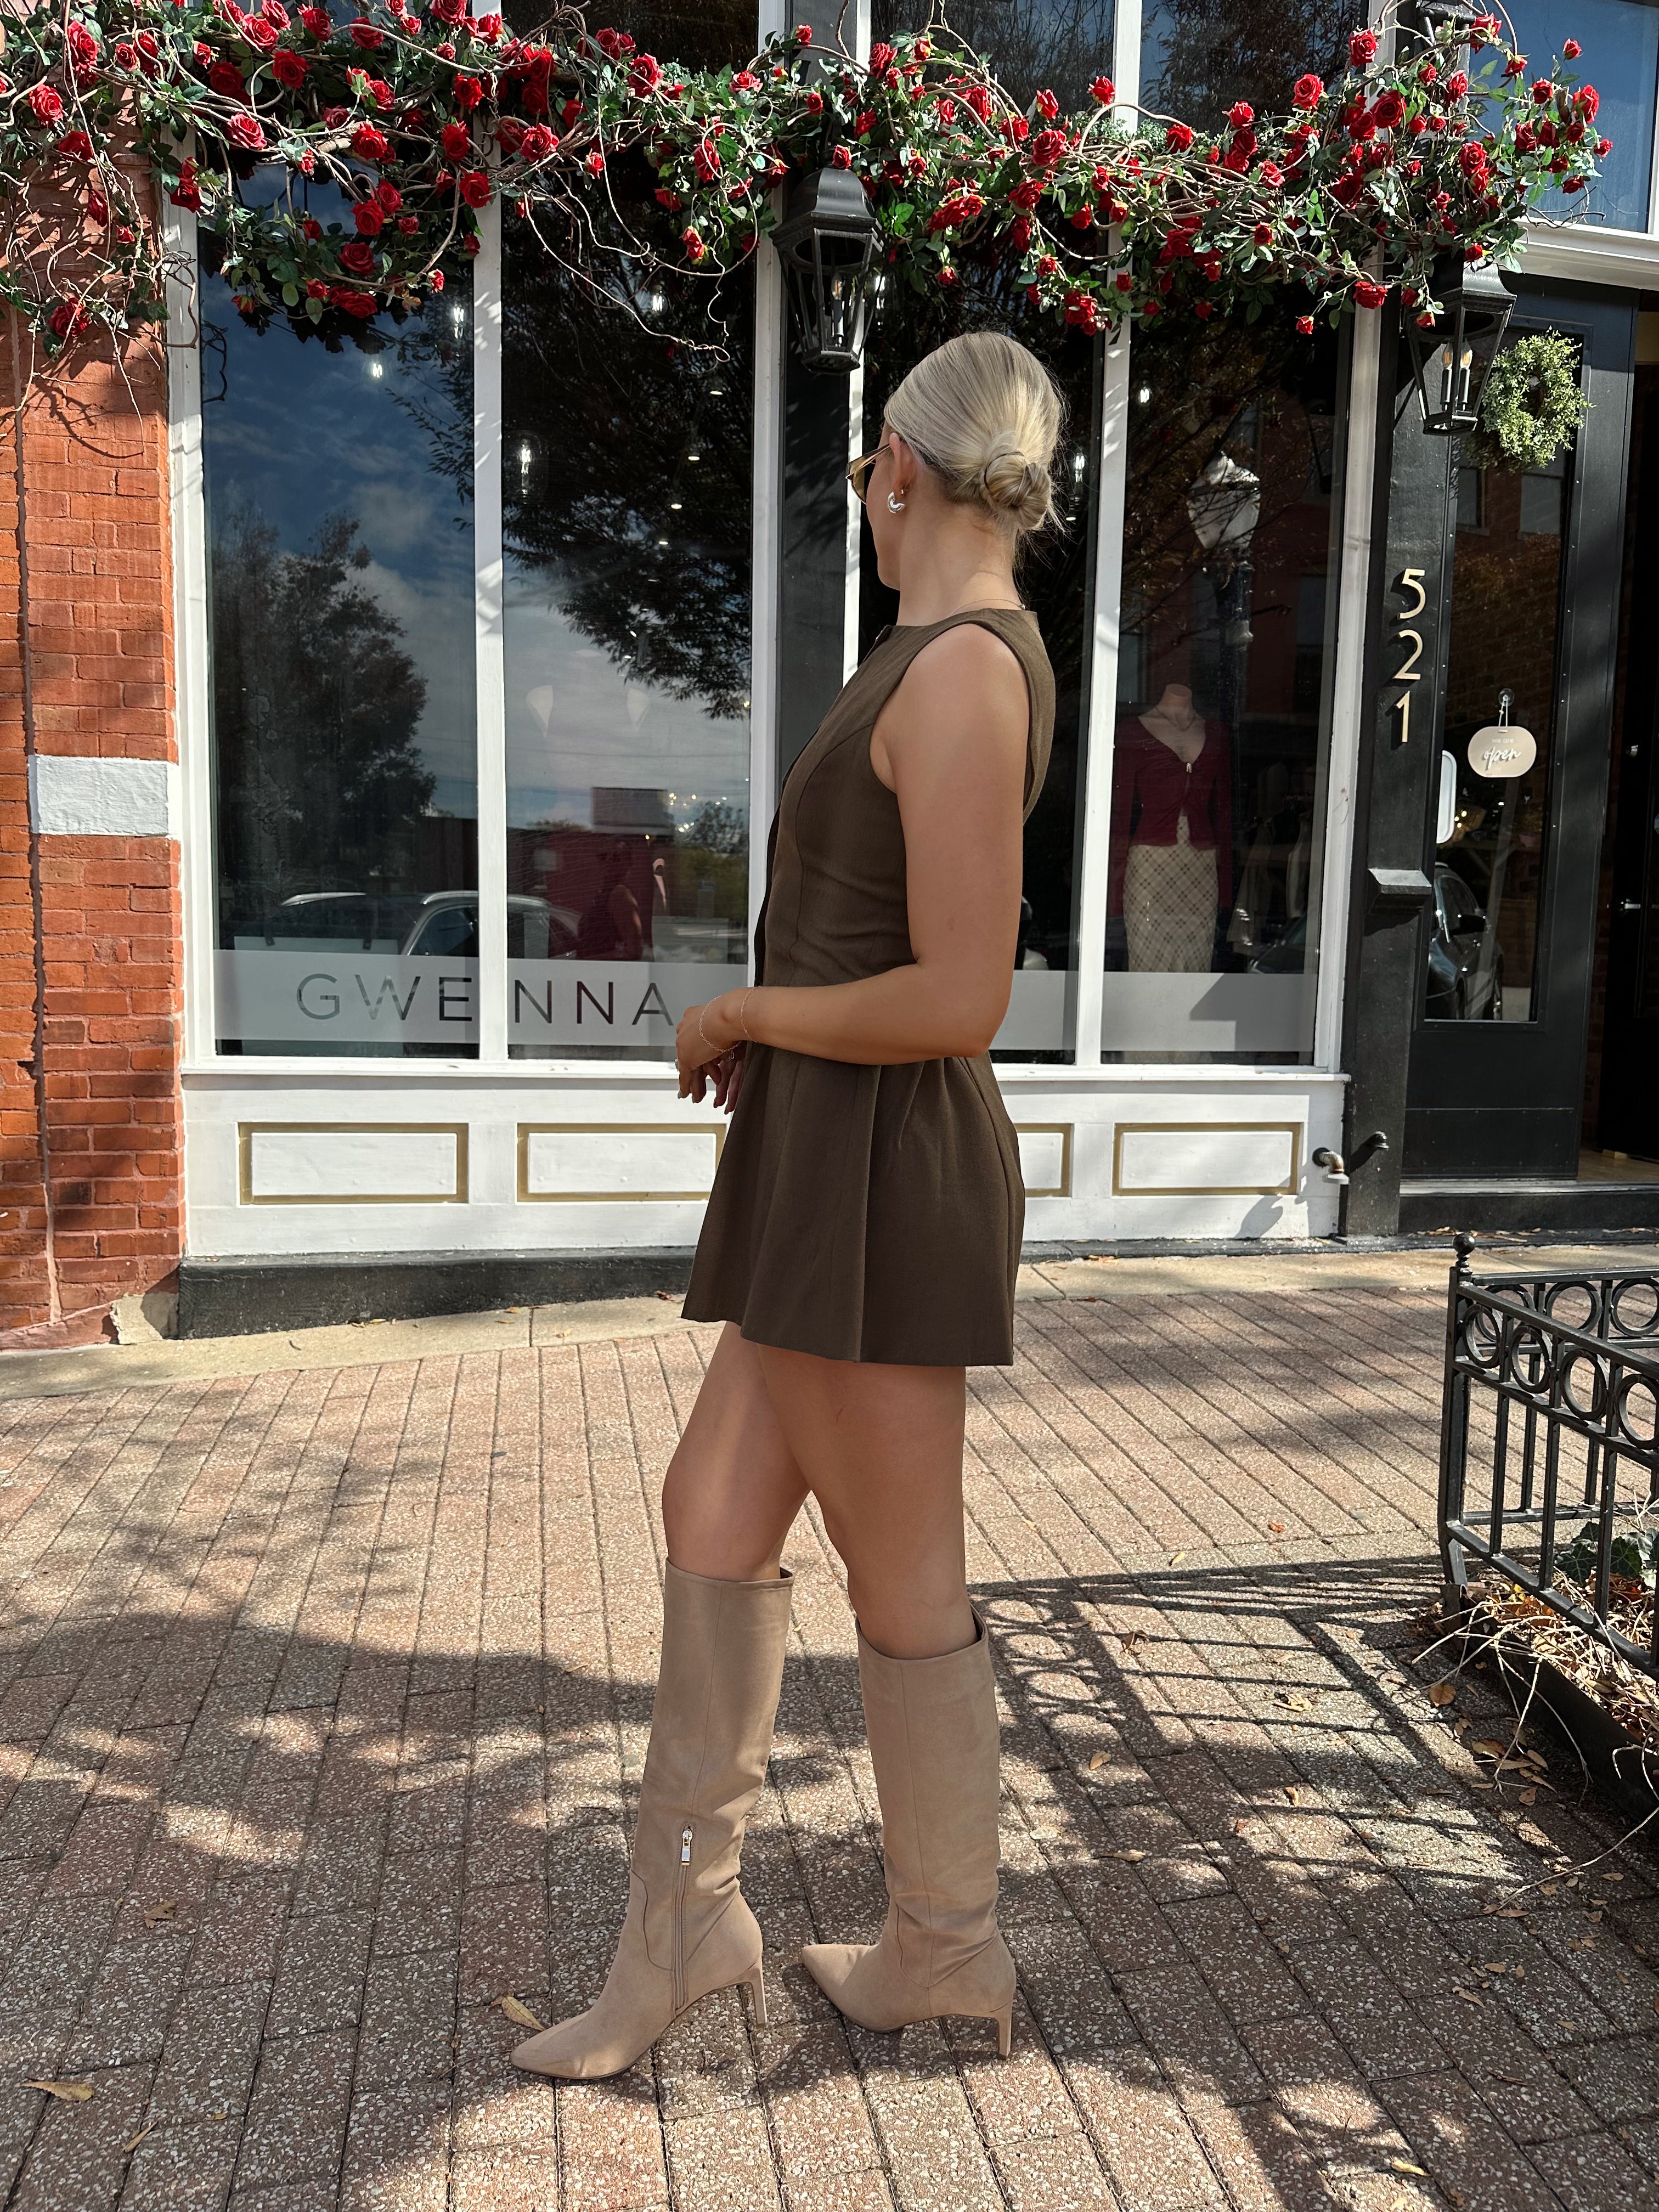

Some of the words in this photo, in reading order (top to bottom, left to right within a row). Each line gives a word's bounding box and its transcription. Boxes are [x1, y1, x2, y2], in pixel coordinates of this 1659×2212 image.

[1393, 568, 1426, 743] 521
[1483, 746, 1521, 769] open
[297, 973, 674, 1026] GWENNA
